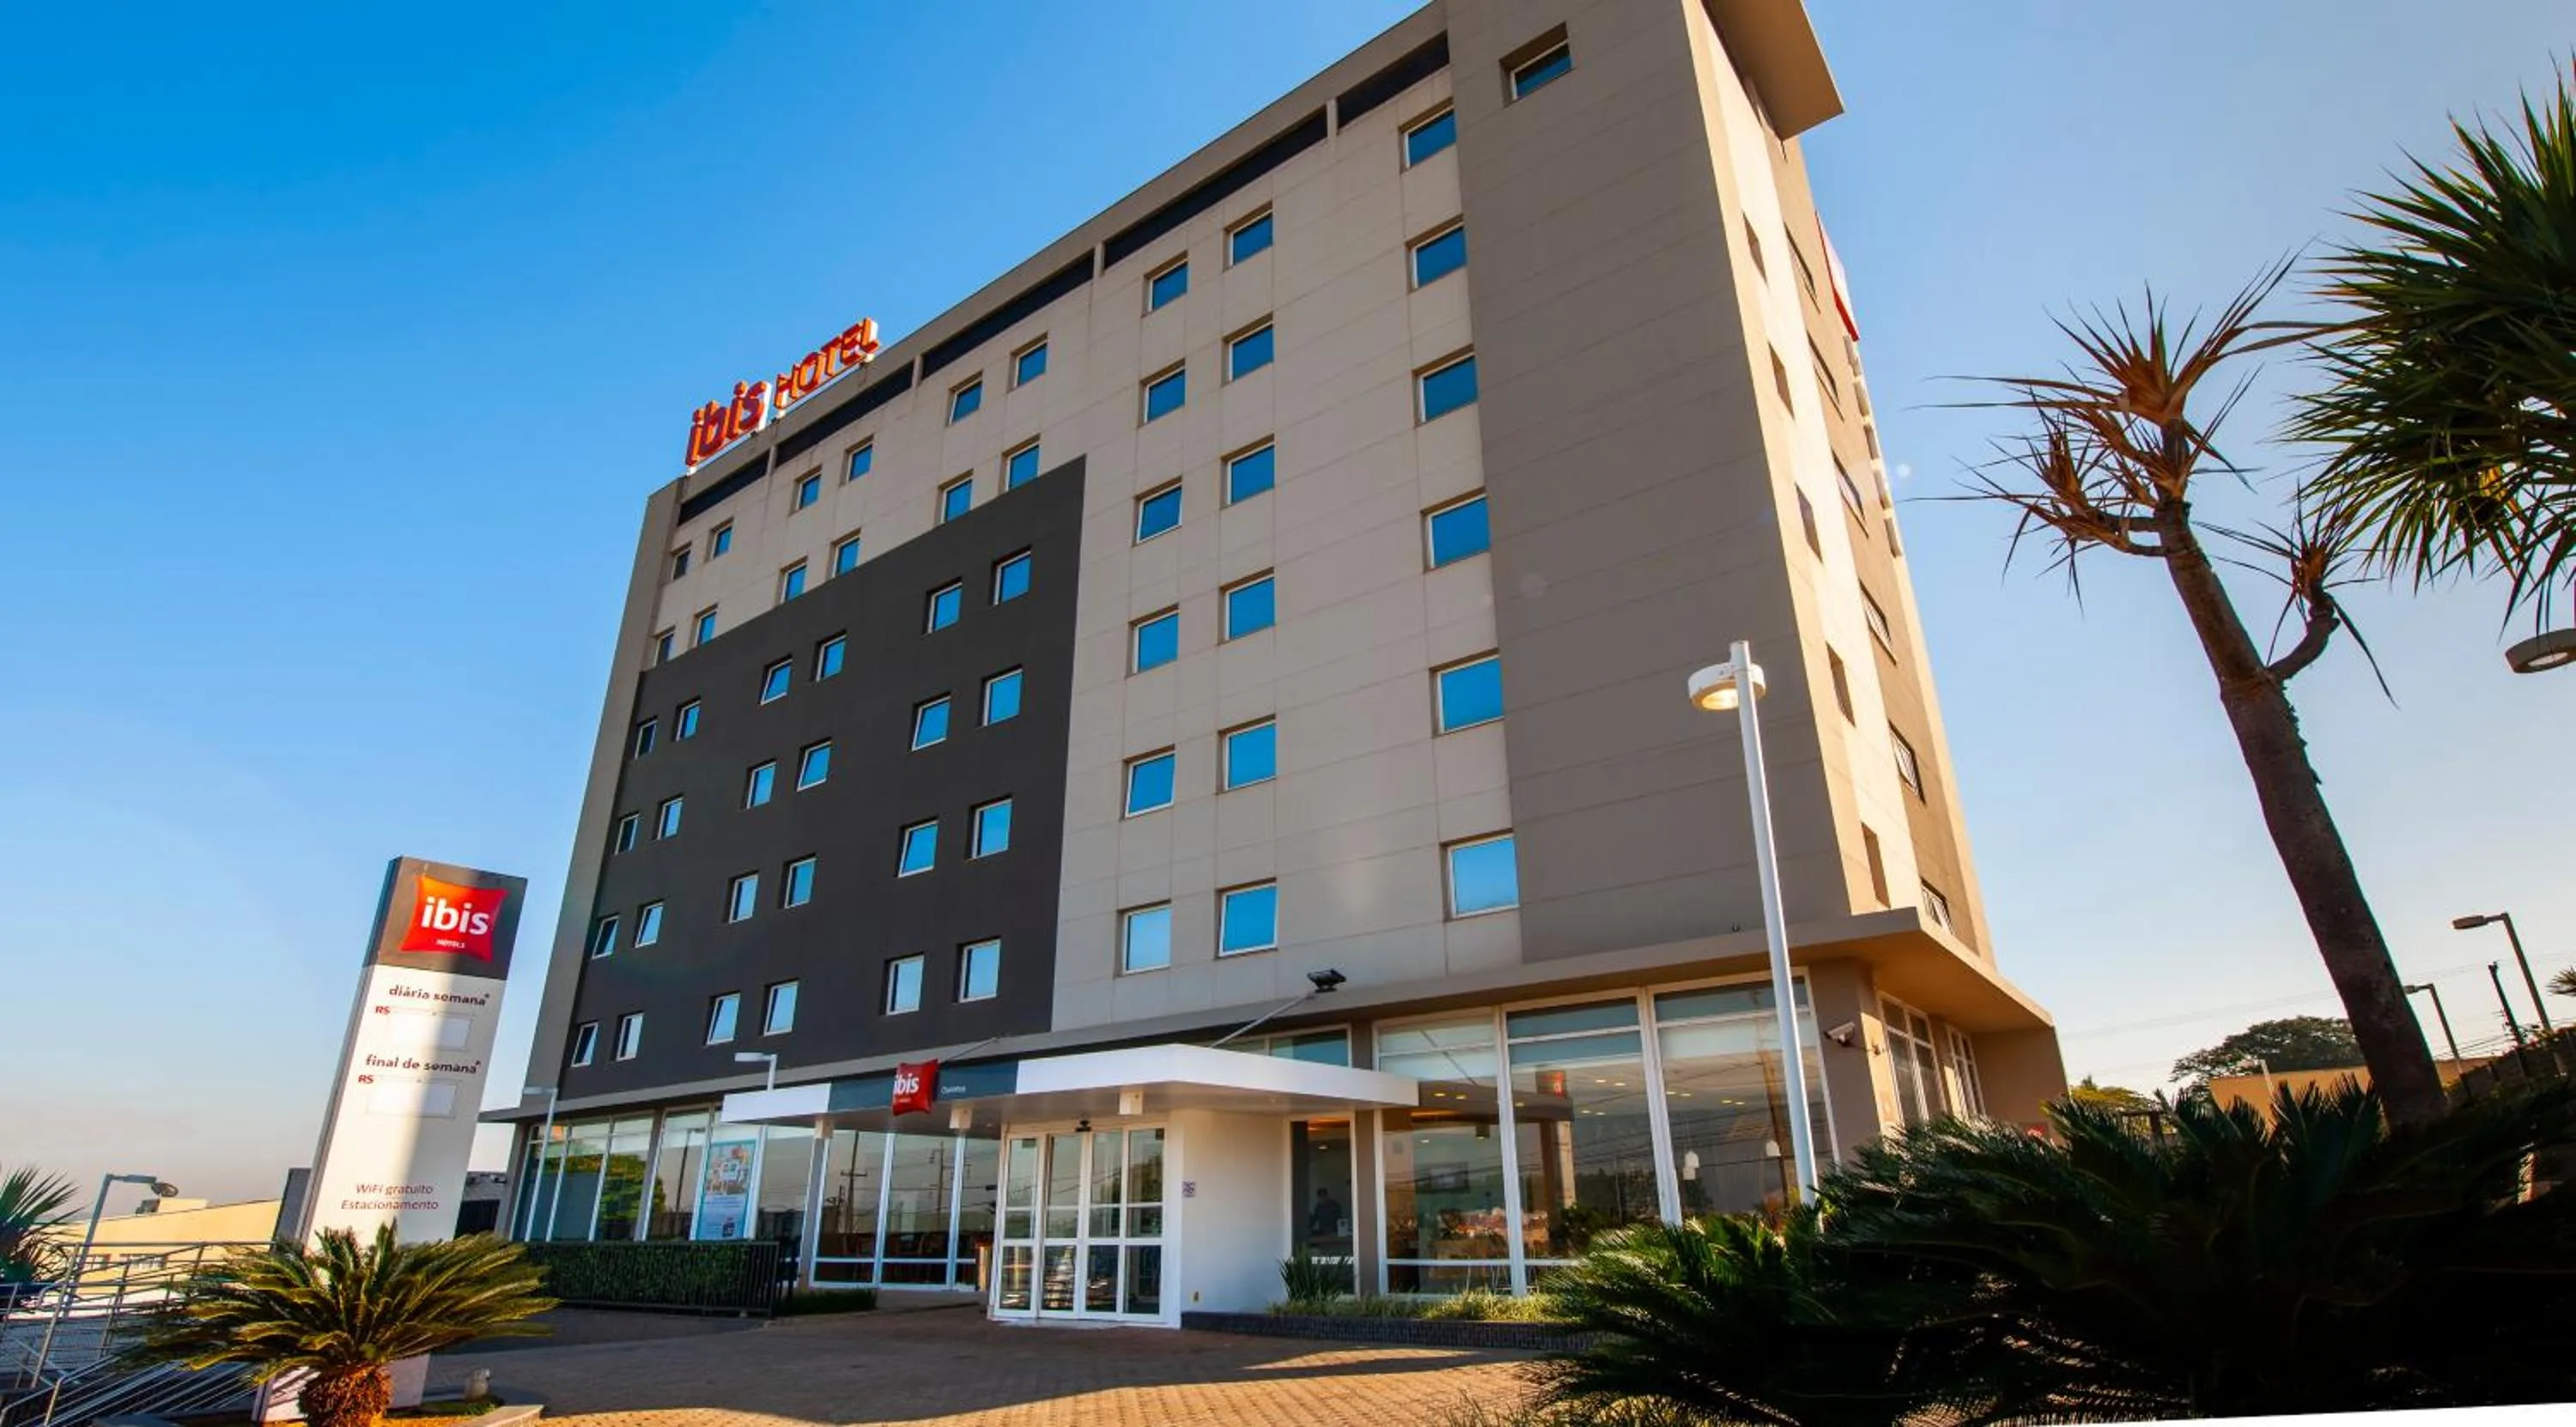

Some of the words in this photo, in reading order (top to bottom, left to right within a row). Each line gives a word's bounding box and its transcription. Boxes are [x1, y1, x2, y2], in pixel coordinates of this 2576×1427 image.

[685, 381, 769, 466] ibis
[774, 316, 880, 410] HOTEL
[421, 896, 490, 936] ibis
[389, 984, 430, 999] diária
[366, 1054, 400, 1068] final
[402, 1057, 421, 1070] de
[892, 1072, 920, 1096] ibis
[355, 1183, 383, 1194] WiFi
[385, 1184, 434, 1196] gratuito
[341, 1199, 440, 1211] Estacionamento
